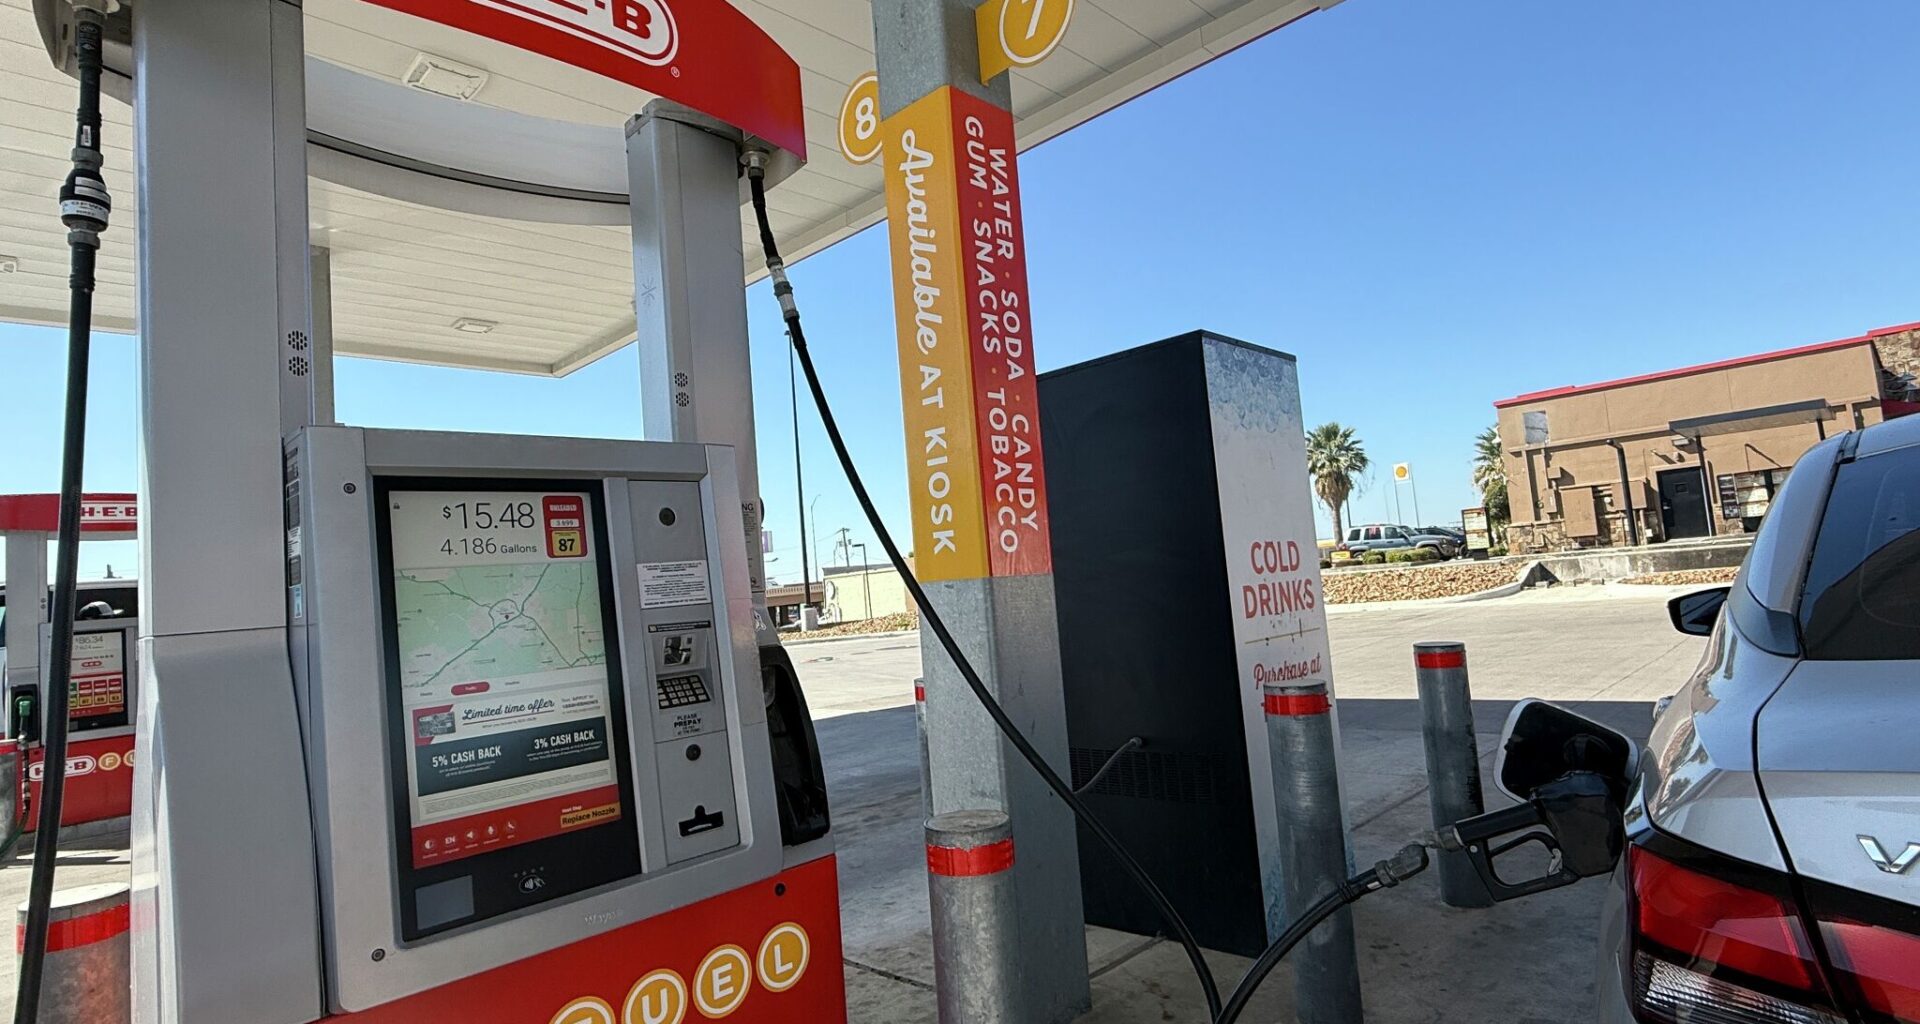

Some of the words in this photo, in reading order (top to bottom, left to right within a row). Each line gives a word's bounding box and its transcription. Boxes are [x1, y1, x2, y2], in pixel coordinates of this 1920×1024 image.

[855, 97, 876, 140] 8
[965, 115, 988, 190] GUM
[989, 149, 1014, 260] WATER
[899, 129, 943, 355] Available
[973, 218, 1001, 354] SNACKS
[1001, 289, 1025, 381] SODA
[920, 365, 944, 409] AT
[924, 426, 956, 555] KIOSK
[987, 388, 1019, 553] TOBACCO
[1011, 414, 1039, 530] CANDY
[81, 506, 137, 517] H-E-B
[442, 502, 535, 530] $15.48
[440, 537, 497, 556] 4.186
[500, 543, 537, 554] Gallons
[558, 538, 576, 552] 87
[1250, 540, 1300, 575] COLD
[1242, 578, 1316, 619] DRINKS
[1253, 659, 1309, 690] Purchase
[1310, 652, 1323, 678] at
[462, 704, 503, 720] Limited
[504, 702, 526, 714] time
[527, 698, 555, 713] offer
[432, 754, 448, 767] 5%
[451, 750, 475, 764] CASH
[478, 745, 502, 759] BACK
[534, 738, 548, 749] 3%
[550, 733, 572, 746] CASH
[574, 729, 595, 742] BACK
[562, 813, 591, 825] Replace
[592, 807, 616, 818] Nozzle
